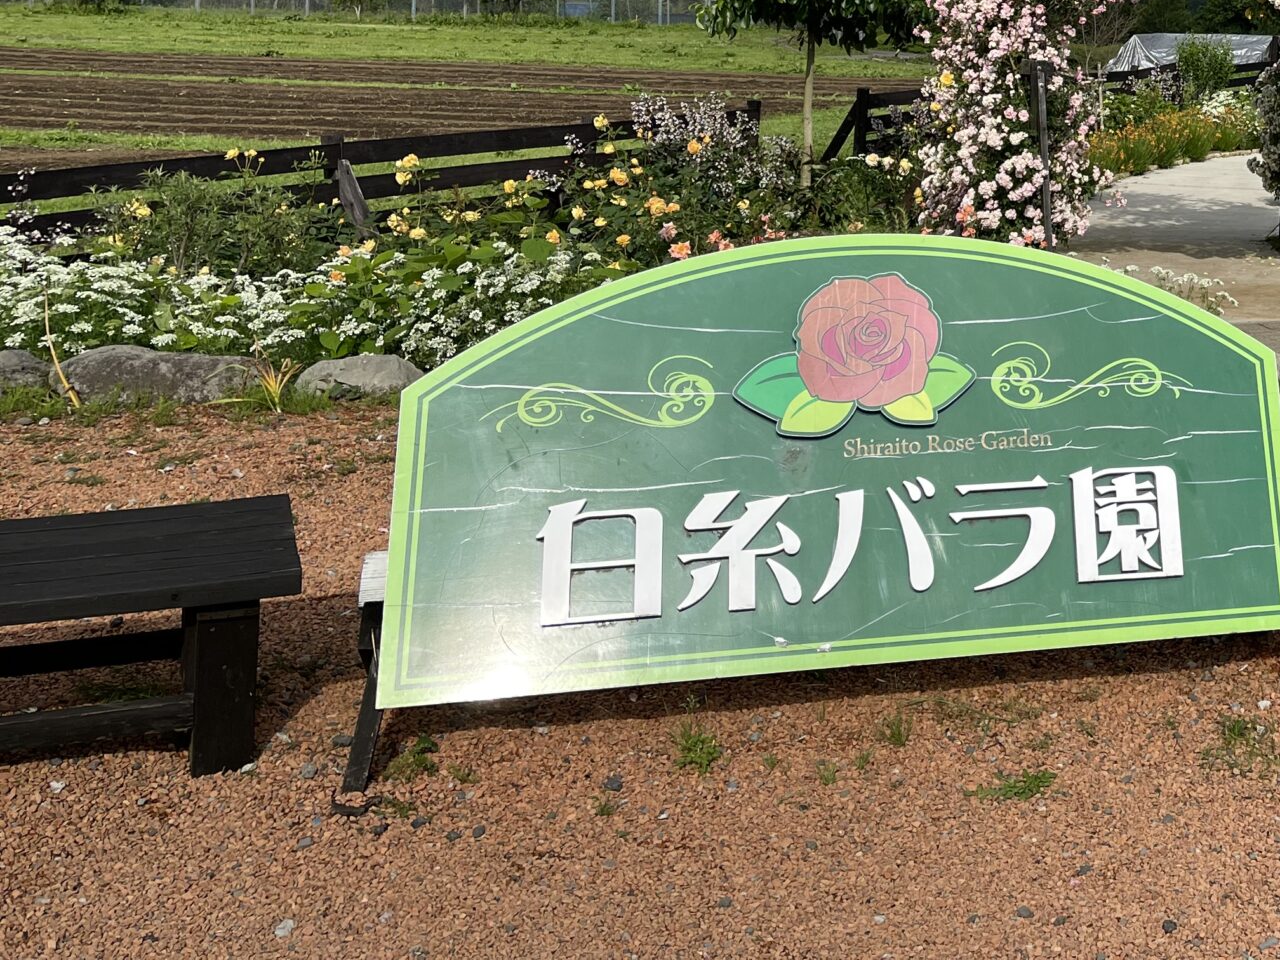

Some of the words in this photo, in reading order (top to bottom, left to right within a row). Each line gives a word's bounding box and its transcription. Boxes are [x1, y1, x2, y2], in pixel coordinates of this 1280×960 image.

[843, 437, 921, 458] Shiraito
[926, 434, 976, 453] Rose
[980, 428, 1053, 450] Garden
[536, 465, 1185, 627] 白糸バラ園
